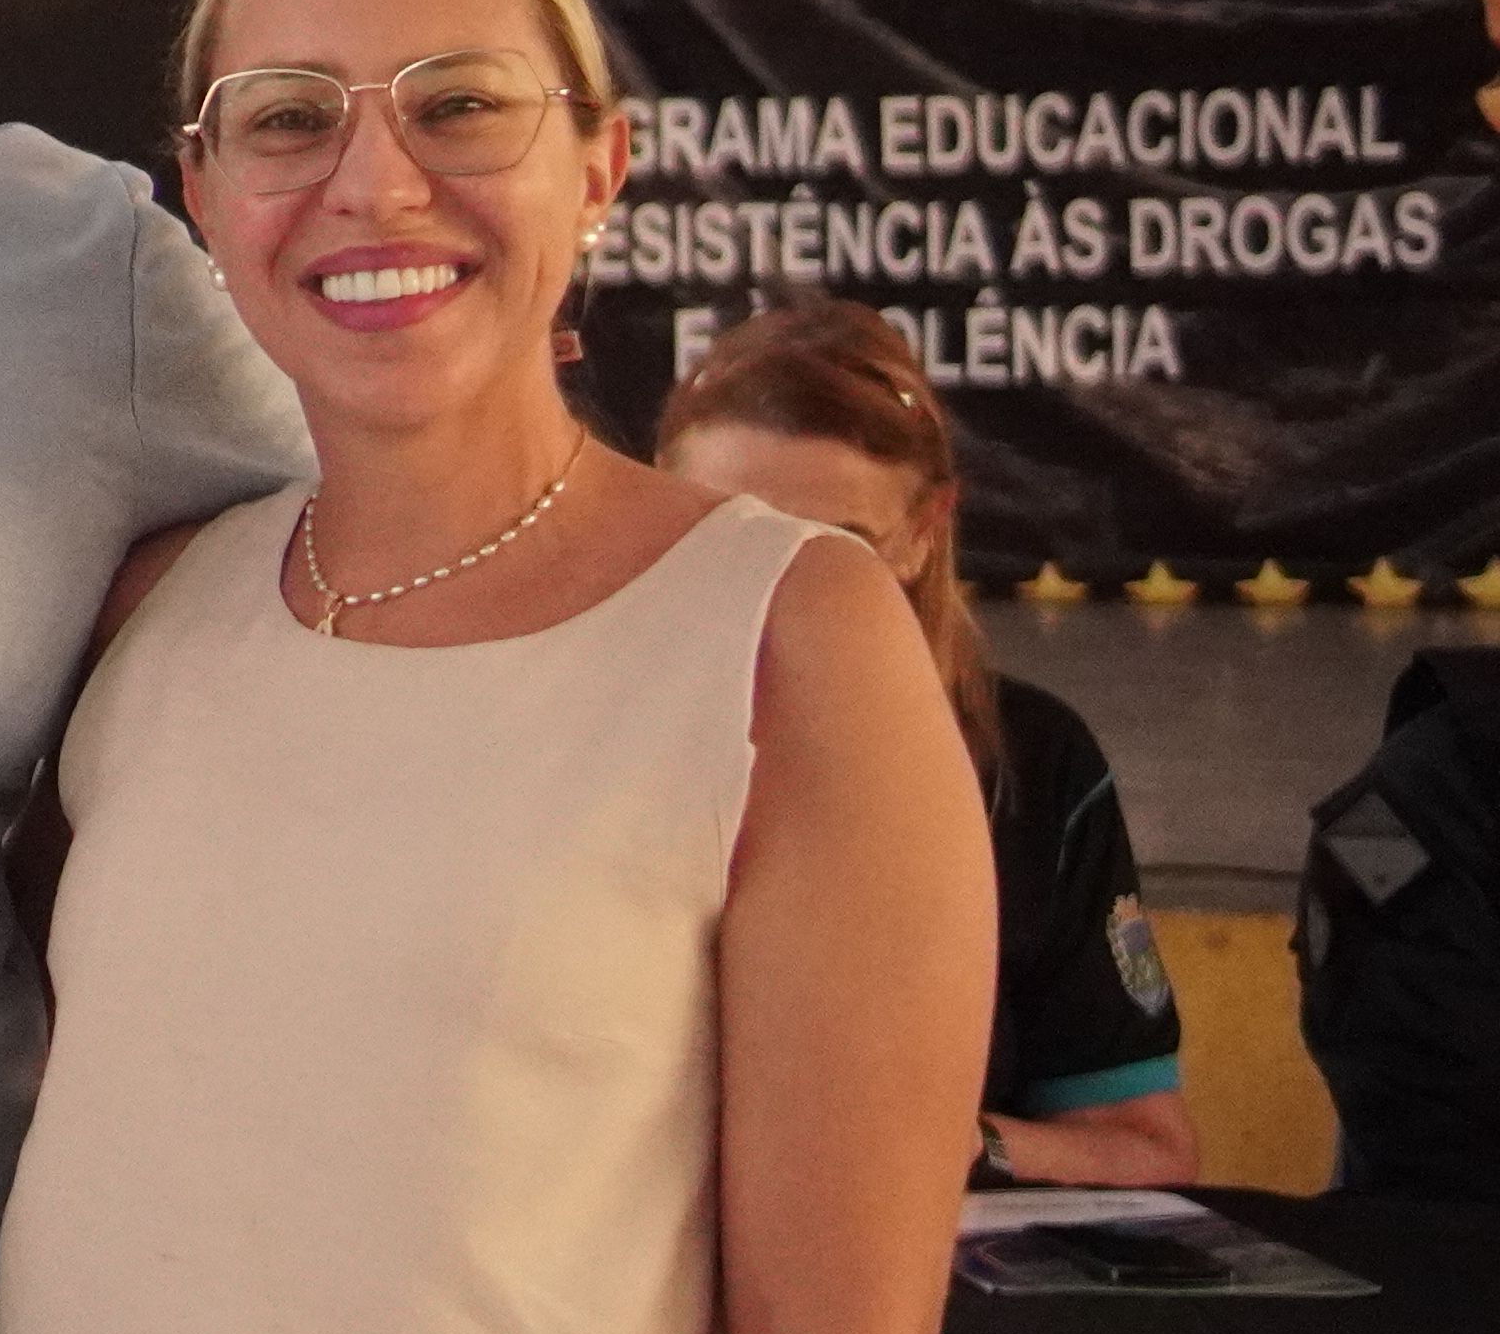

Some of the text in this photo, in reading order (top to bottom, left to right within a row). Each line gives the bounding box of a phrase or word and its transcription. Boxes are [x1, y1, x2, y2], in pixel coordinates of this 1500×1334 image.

[621, 85, 1402, 175] GRAMA EDUCACIONAL
[588, 178, 1440, 284] ESISTÊNCIA ÀS DROGAS
